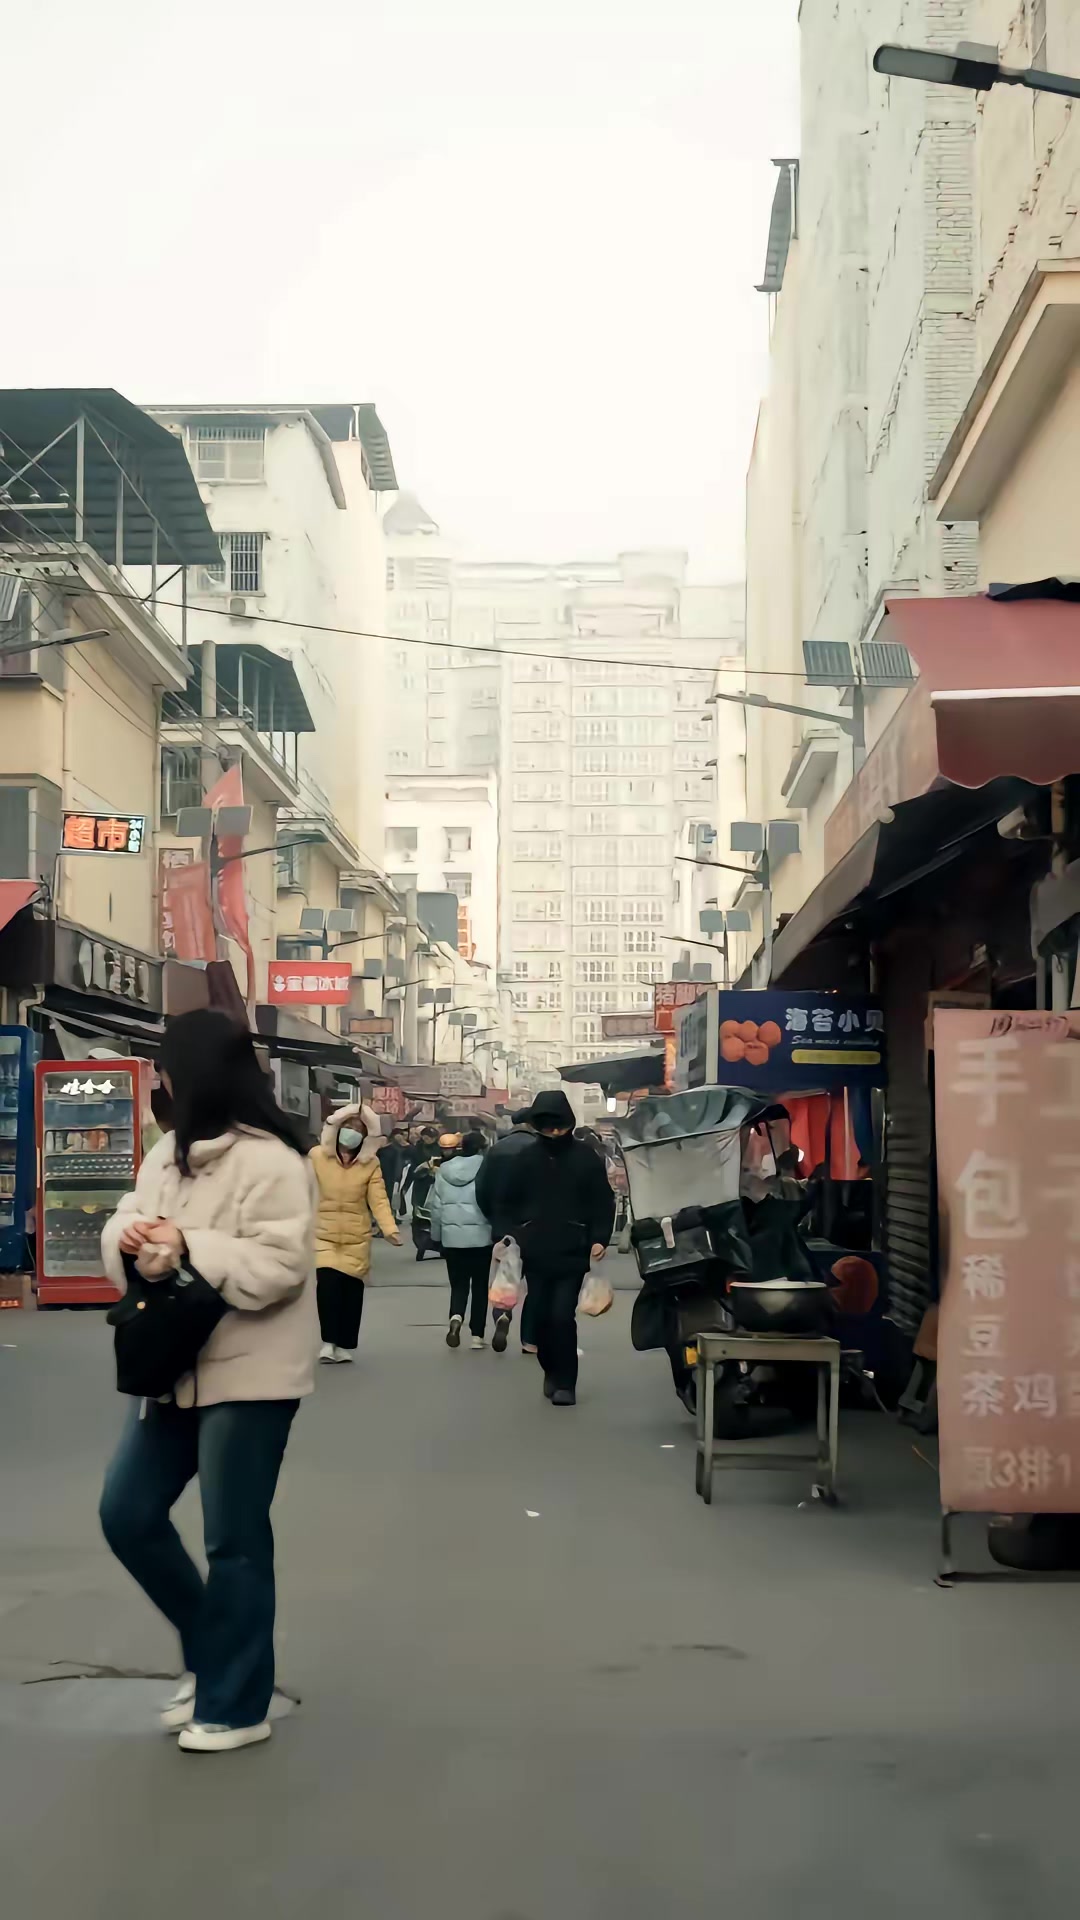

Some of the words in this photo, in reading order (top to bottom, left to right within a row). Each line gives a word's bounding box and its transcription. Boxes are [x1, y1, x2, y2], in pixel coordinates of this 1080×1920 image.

[64, 816, 128, 851] 超市
[785, 1007, 884, 1033] 海苔小贝
